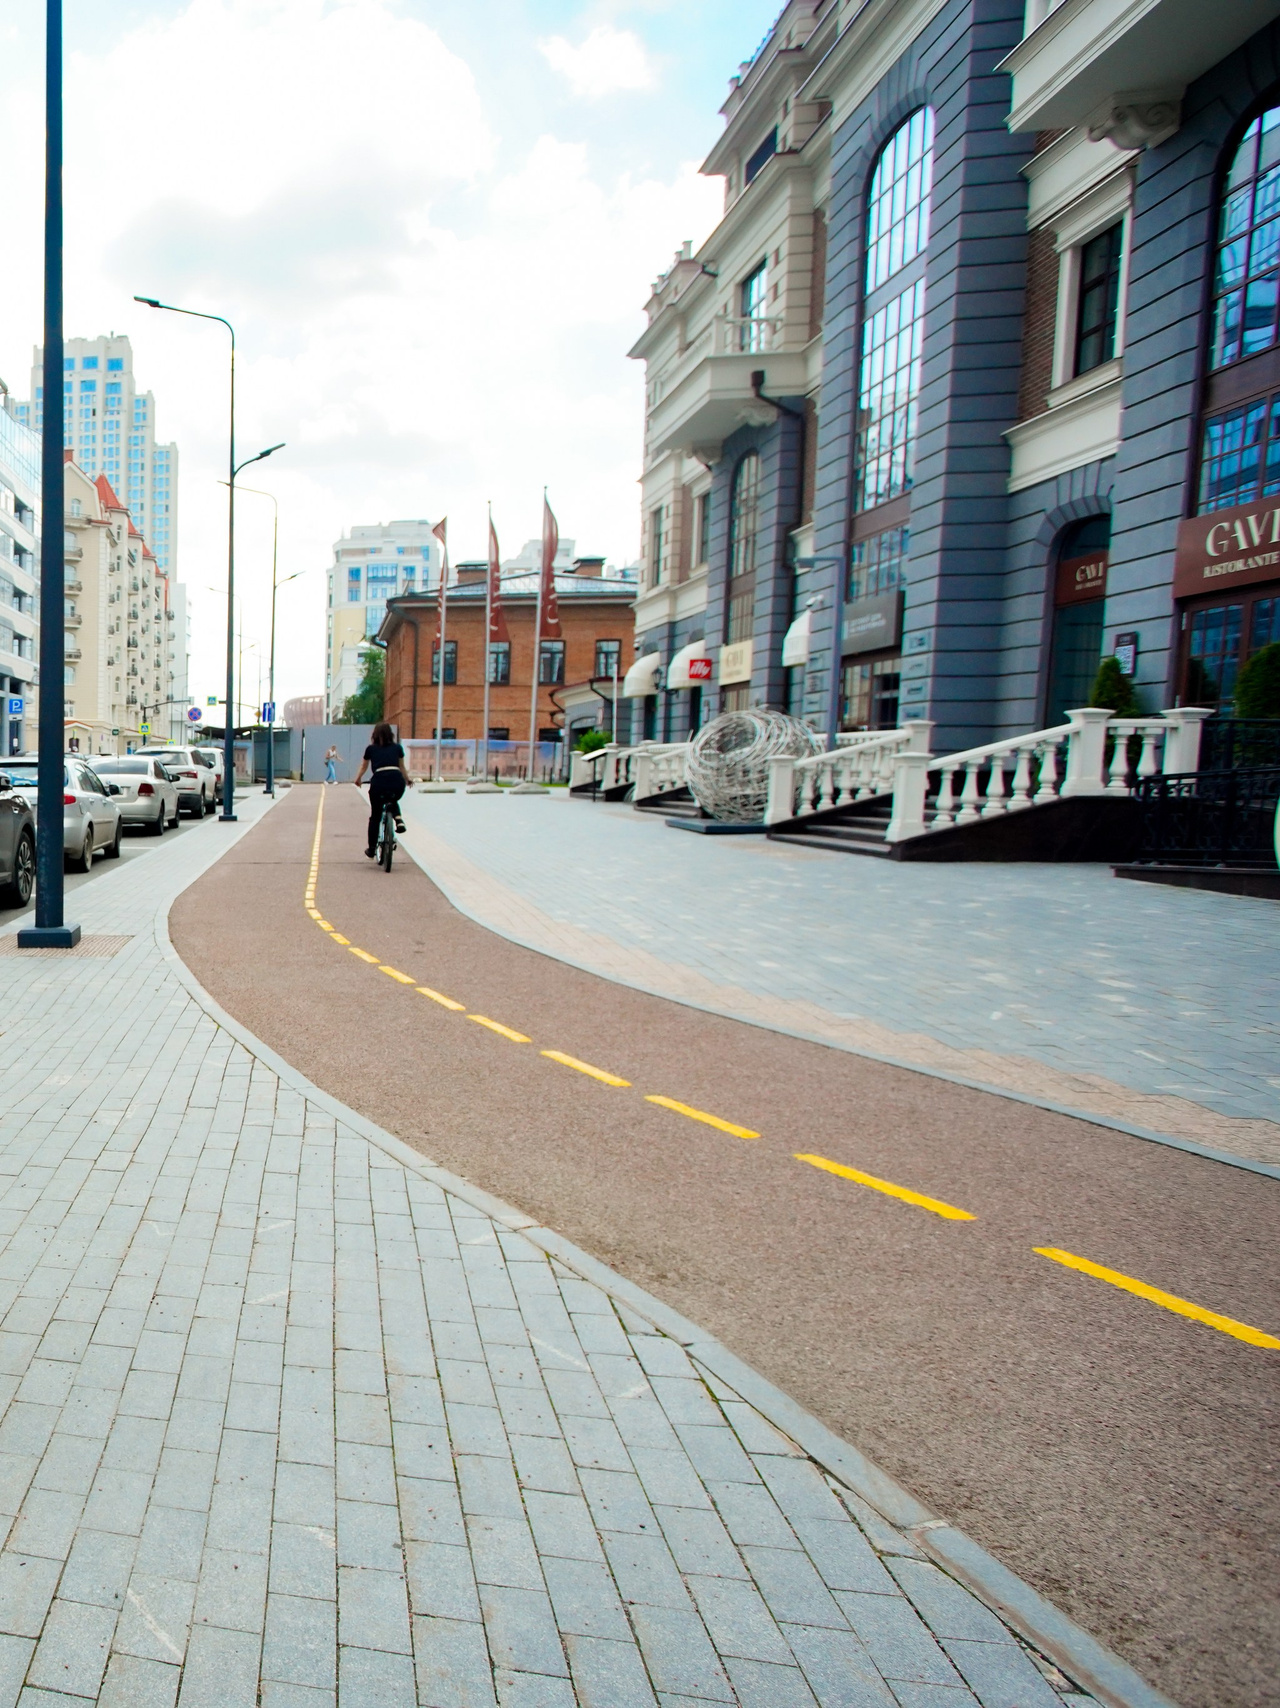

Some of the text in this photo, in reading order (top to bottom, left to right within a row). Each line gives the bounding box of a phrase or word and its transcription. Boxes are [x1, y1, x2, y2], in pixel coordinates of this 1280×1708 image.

[1205, 508, 1280, 557] GAVI
[1203, 551, 1280, 578] RISTORANTE
[690, 661, 710, 678] illy
